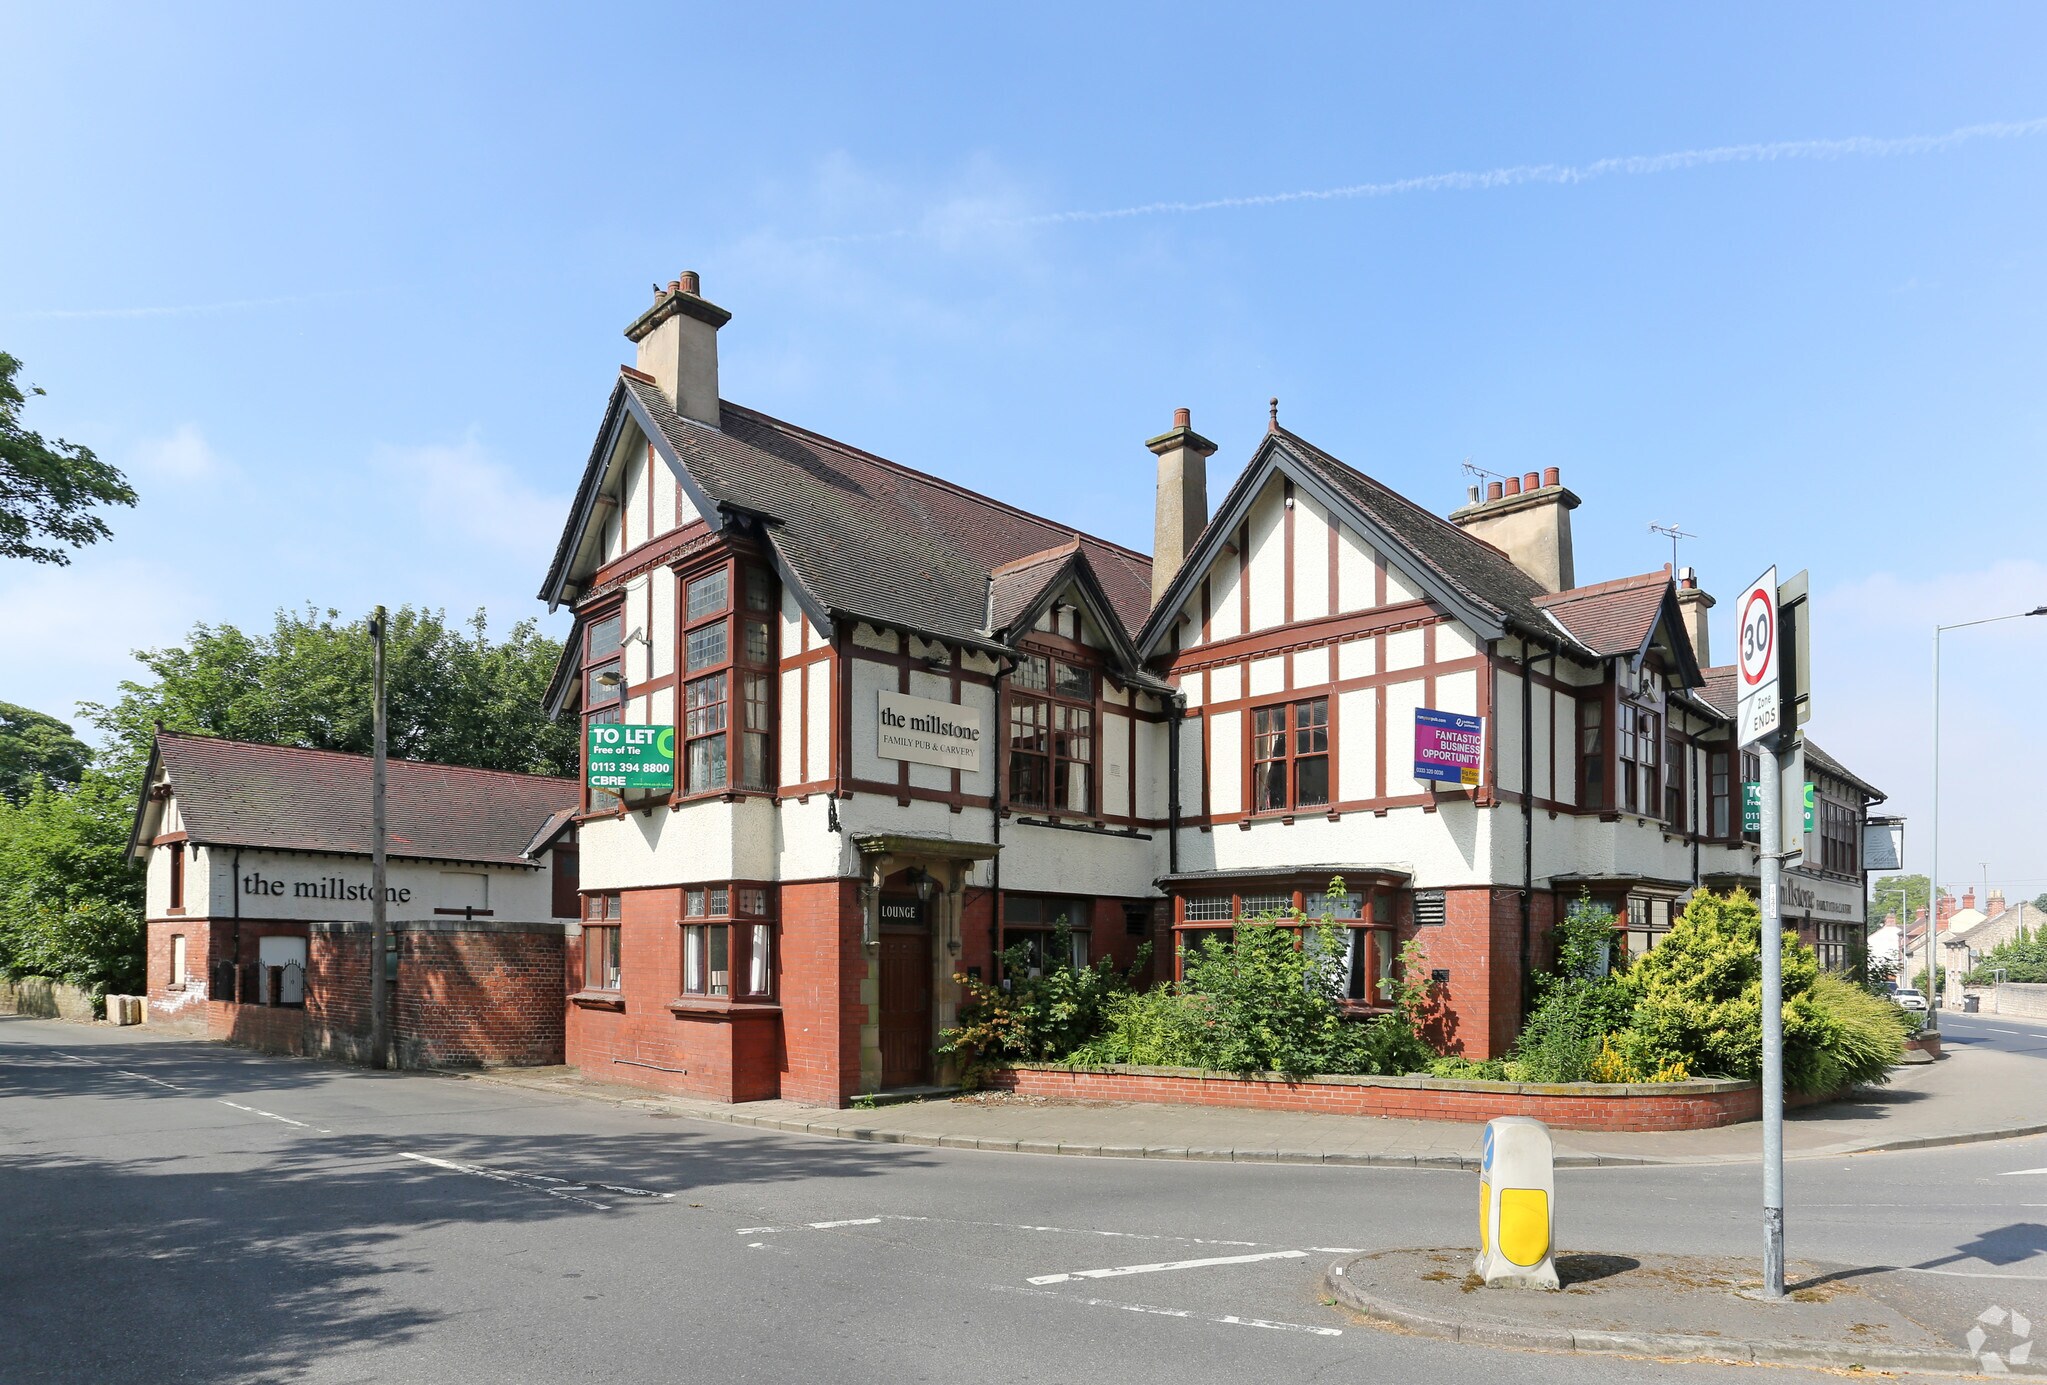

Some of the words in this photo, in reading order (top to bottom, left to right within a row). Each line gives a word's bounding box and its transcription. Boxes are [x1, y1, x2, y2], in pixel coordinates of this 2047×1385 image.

[1744, 613, 1768, 661] 30
[1757, 694, 1772, 710] Zone
[881, 707, 906, 728] the
[910, 714, 980, 741] millstone
[1754, 707, 1776, 731] ENDS
[593, 728, 620, 744] TO
[625, 729, 655, 744] LET
[1435, 730, 1481, 745] FANTASTIC
[593, 745, 613, 754] Free
[615, 745, 626, 754] of
[626, 746, 641, 755] Tie
[883, 734, 914, 747] FAMILY
[915, 740, 931, 750] PUB
[931, 743, 939, 751] &
[940, 744, 975, 757] CARVERY
[1440, 741, 1481, 755] BUSINESS
[1422, 748, 1480, 765] OPPORTUNITY
[591, 762, 616, 772] 0113
[619, 762, 640, 773] 394
[642, 763, 670, 773] 8800
[591, 775, 627, 786] CBRE
[243, 872, 285, 897] the
[881, 905, 916, 919] LOUNGE
